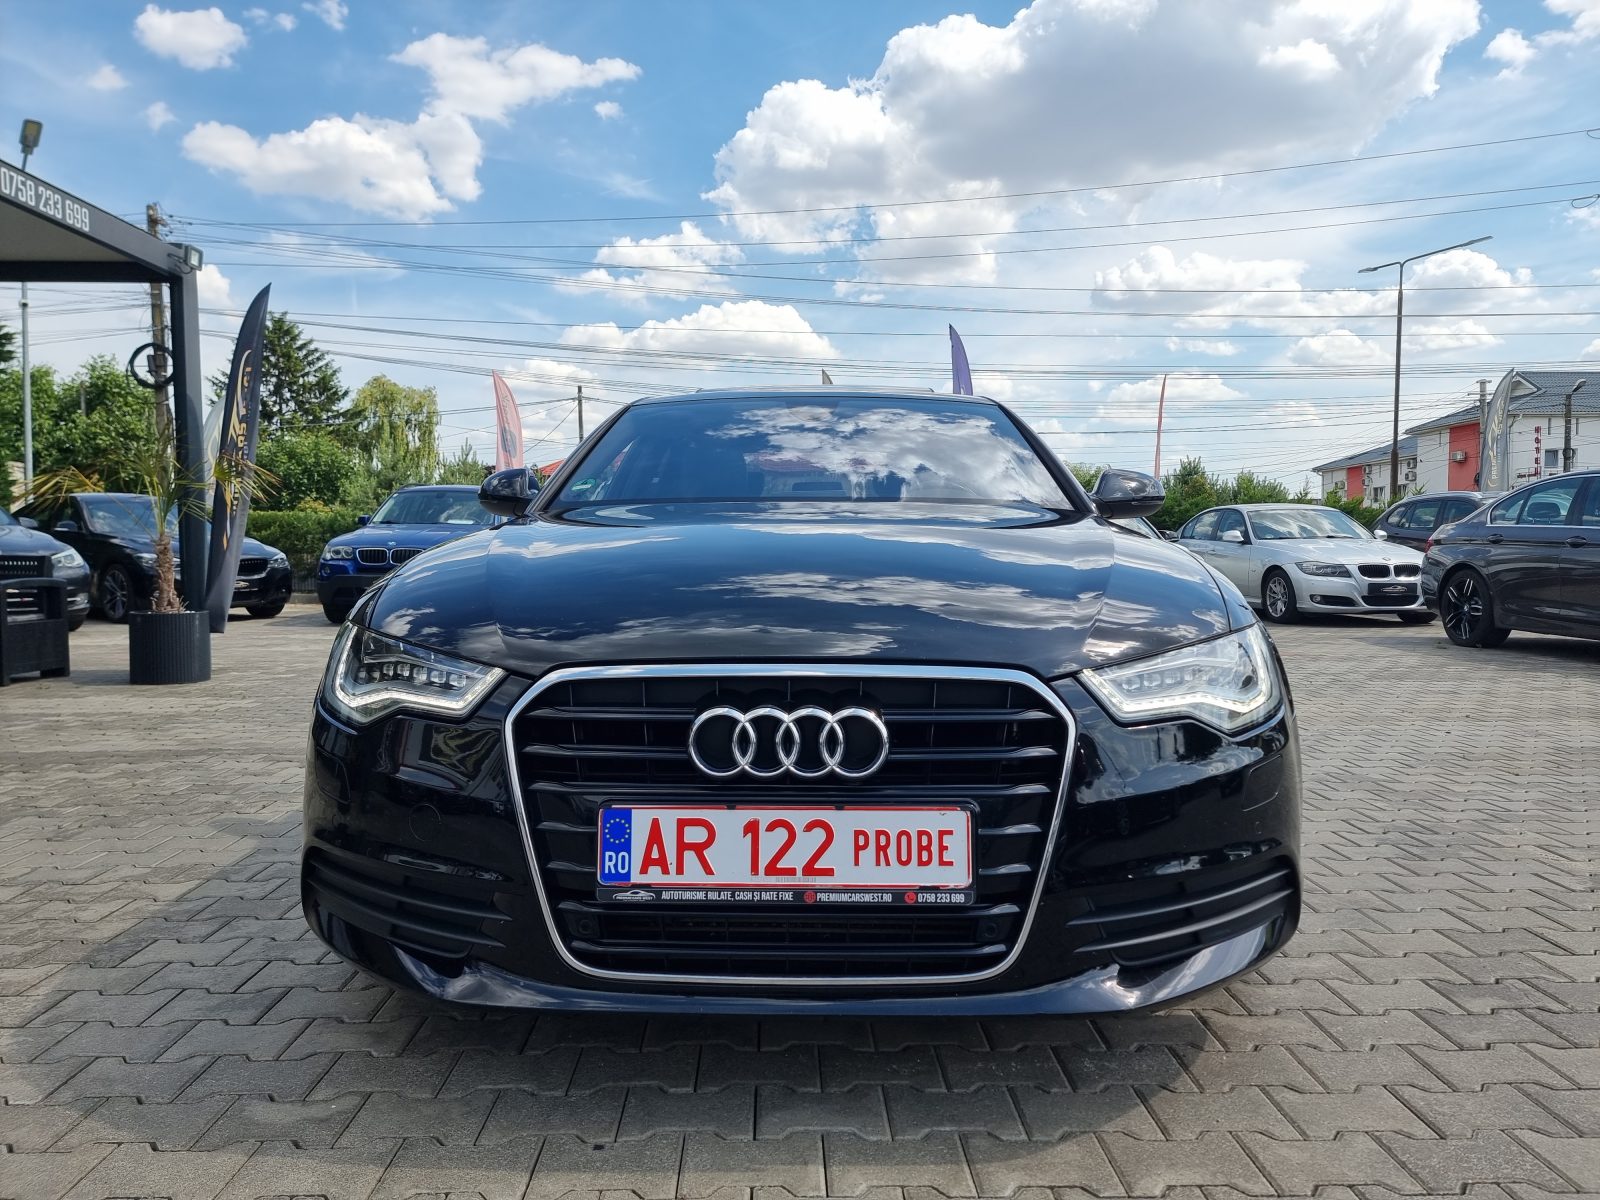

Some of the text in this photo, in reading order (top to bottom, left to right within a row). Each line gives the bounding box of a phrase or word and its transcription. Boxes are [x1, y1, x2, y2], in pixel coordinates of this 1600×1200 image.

[1, 167, 89, 232] 0758 233 699
[639, 817, 954, 877] AR 122 PROBE
[604, 852, 629, 874] RO
[661, 891, 707, 900] AUTOTURISME
[708, 891, 733, 901] RULATE,
[735, 892, 752, 901] CASH
[761, 892, 778, 901] RATE
[779, 892, 794, 901] FIXE
[817, 893, 892, 902] PREMIUMCARSWEST.RO
[918, 893, 965, 903] 0758 233 699
